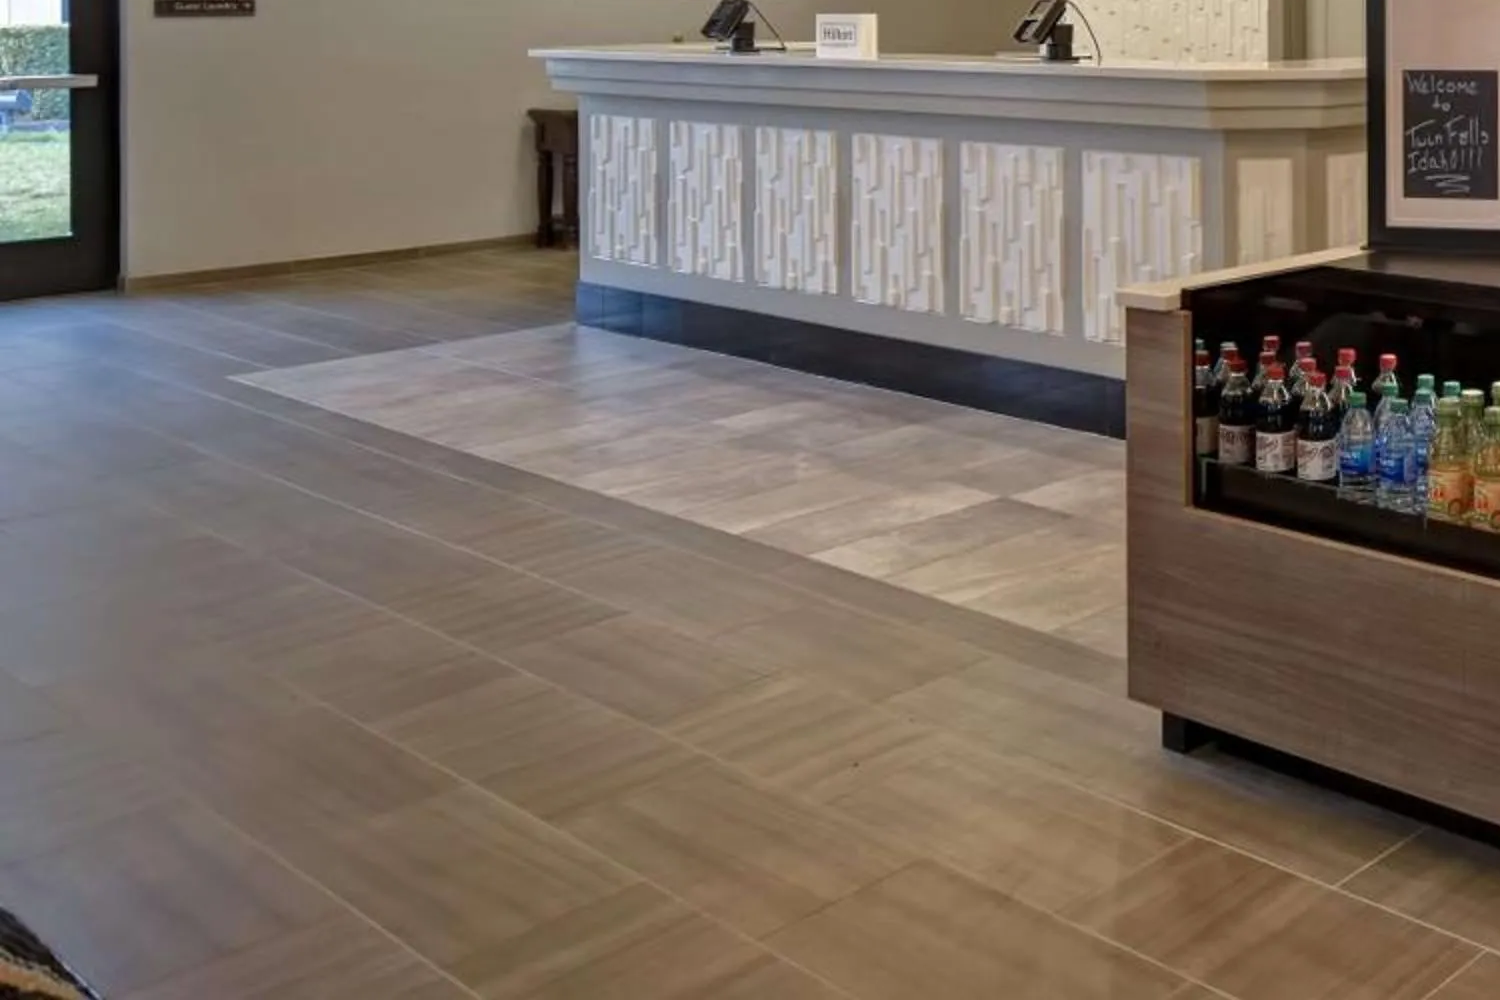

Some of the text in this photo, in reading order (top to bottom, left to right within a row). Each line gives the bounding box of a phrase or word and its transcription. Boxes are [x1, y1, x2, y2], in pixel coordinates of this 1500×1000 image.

[1404, 72, 1479, 95] Welcome
[1431, 95, 1451, 112] to
[1404, 115, 1490, 149] Twin Falls
